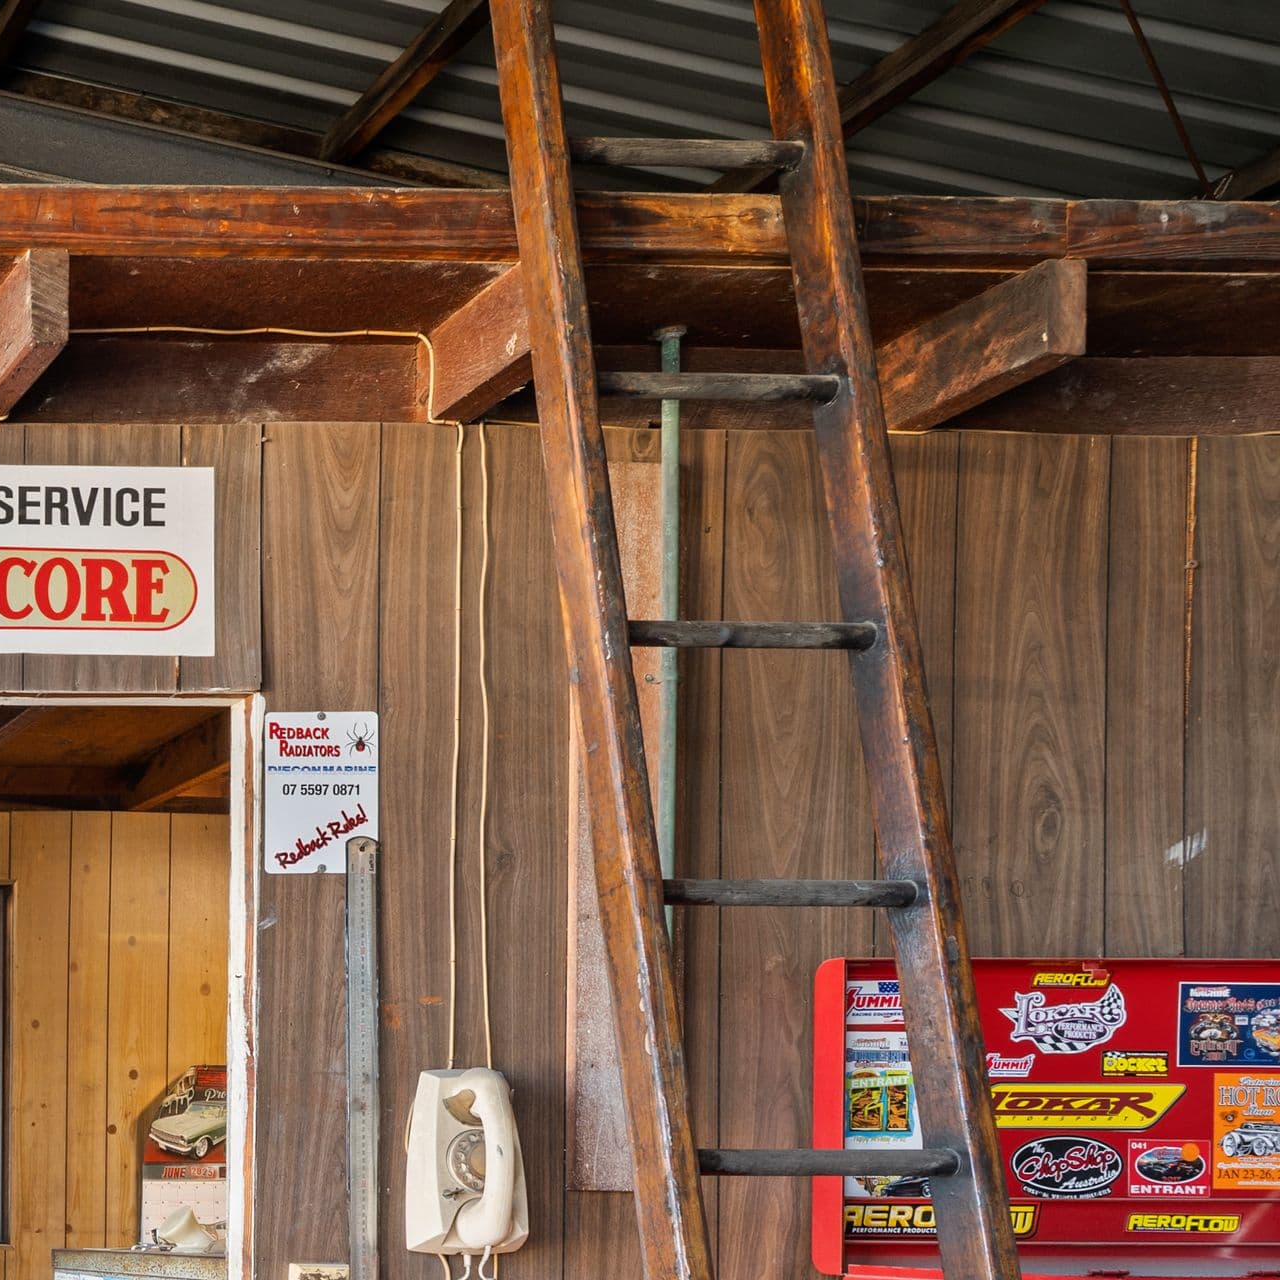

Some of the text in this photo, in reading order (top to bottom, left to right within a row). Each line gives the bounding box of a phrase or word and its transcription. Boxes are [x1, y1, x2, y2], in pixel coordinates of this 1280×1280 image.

[269, 722, 330, 740] REDBACK
[279, 740, 341, 758] RADIATORS
[282, 784, 361, 796] 07 5597 0871
[846, 986, 903, 1010] SUMMI
[851, 1077, 908, 1089] ENTRANT
[1218, 1086, 1260, 1106] HOT
[1131, 1142, 1147, 1150] 041
[162, 1167, 186, 1179] JUNE
[1217, 1169, 1240, 1180] JAN
[1130, 1185, 1207, 1195] ENTRANT
[1128, 1214, 1240, 1232] AEROFLOW
